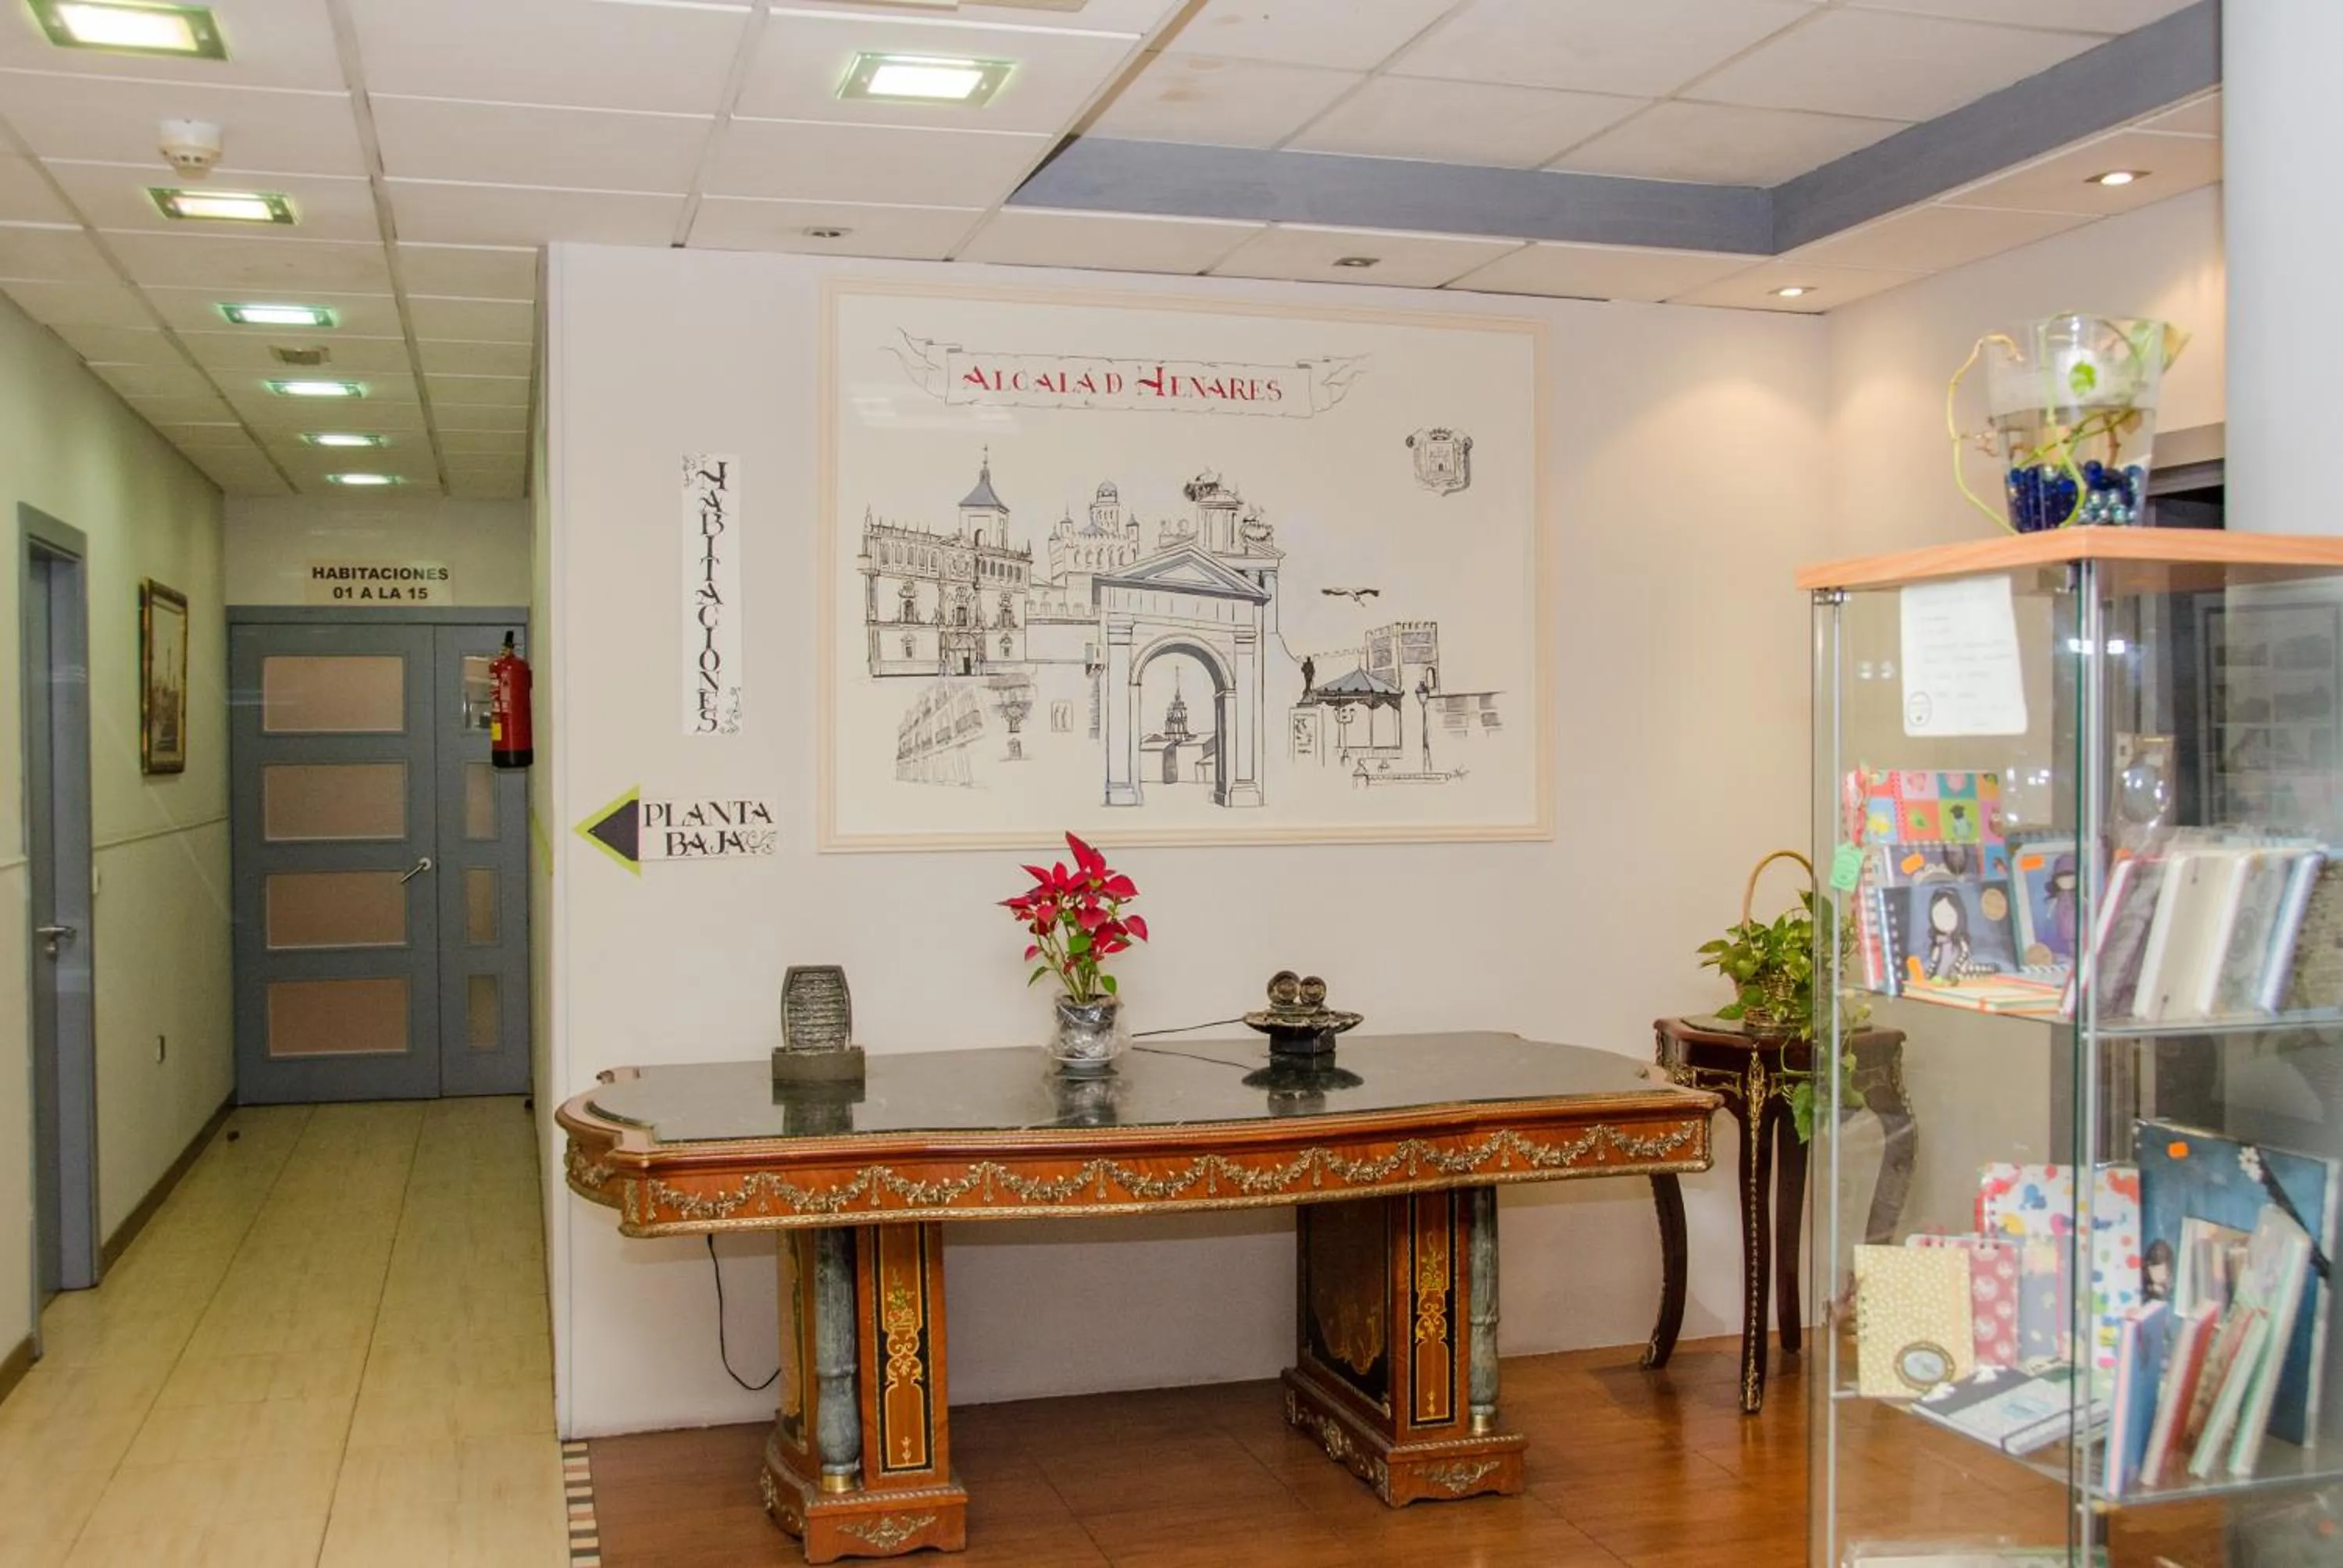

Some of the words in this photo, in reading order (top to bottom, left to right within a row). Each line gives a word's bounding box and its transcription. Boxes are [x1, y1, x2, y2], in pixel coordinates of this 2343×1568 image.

[1136, 365, 1282, 401] HENARES
[312, 567, 449, 580] HABITACIONES
[333, 586, 352, 600] 01
[360, 587, 373, 600] A
[378, 587, 402, 600] LA
[408, 587, 428, 600] 15
[695, 453, 729, 733] HABITACIONES
[643, 800, 773, 828] PLANTA
[665, 830, 746, 856] BAJA
